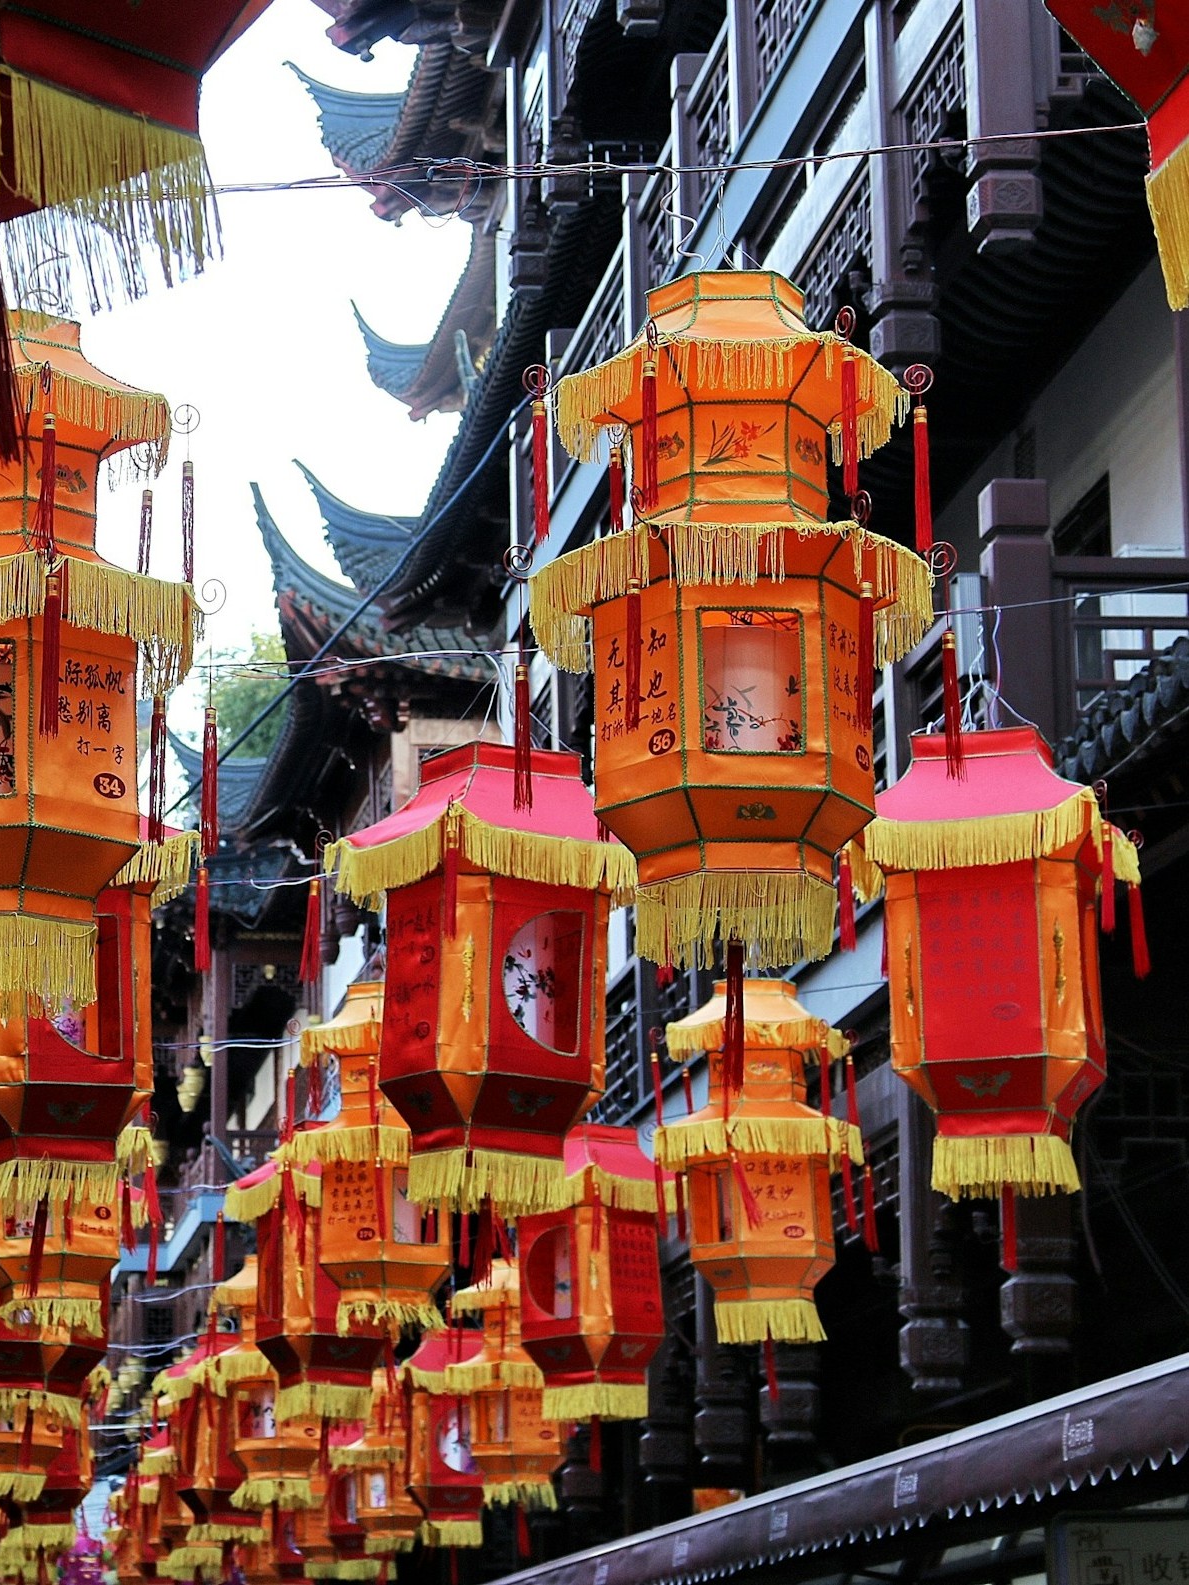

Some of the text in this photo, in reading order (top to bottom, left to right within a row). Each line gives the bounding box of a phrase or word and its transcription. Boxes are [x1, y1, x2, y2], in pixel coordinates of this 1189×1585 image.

[607, 627, 667, 669] 无知
[58, 658, 125, 694] 际孤帆
[605, 669, 667, 714] 其也
[601, 702, 677, 742] 打浙一地名
[76, 736, 125, 766] 打一字
